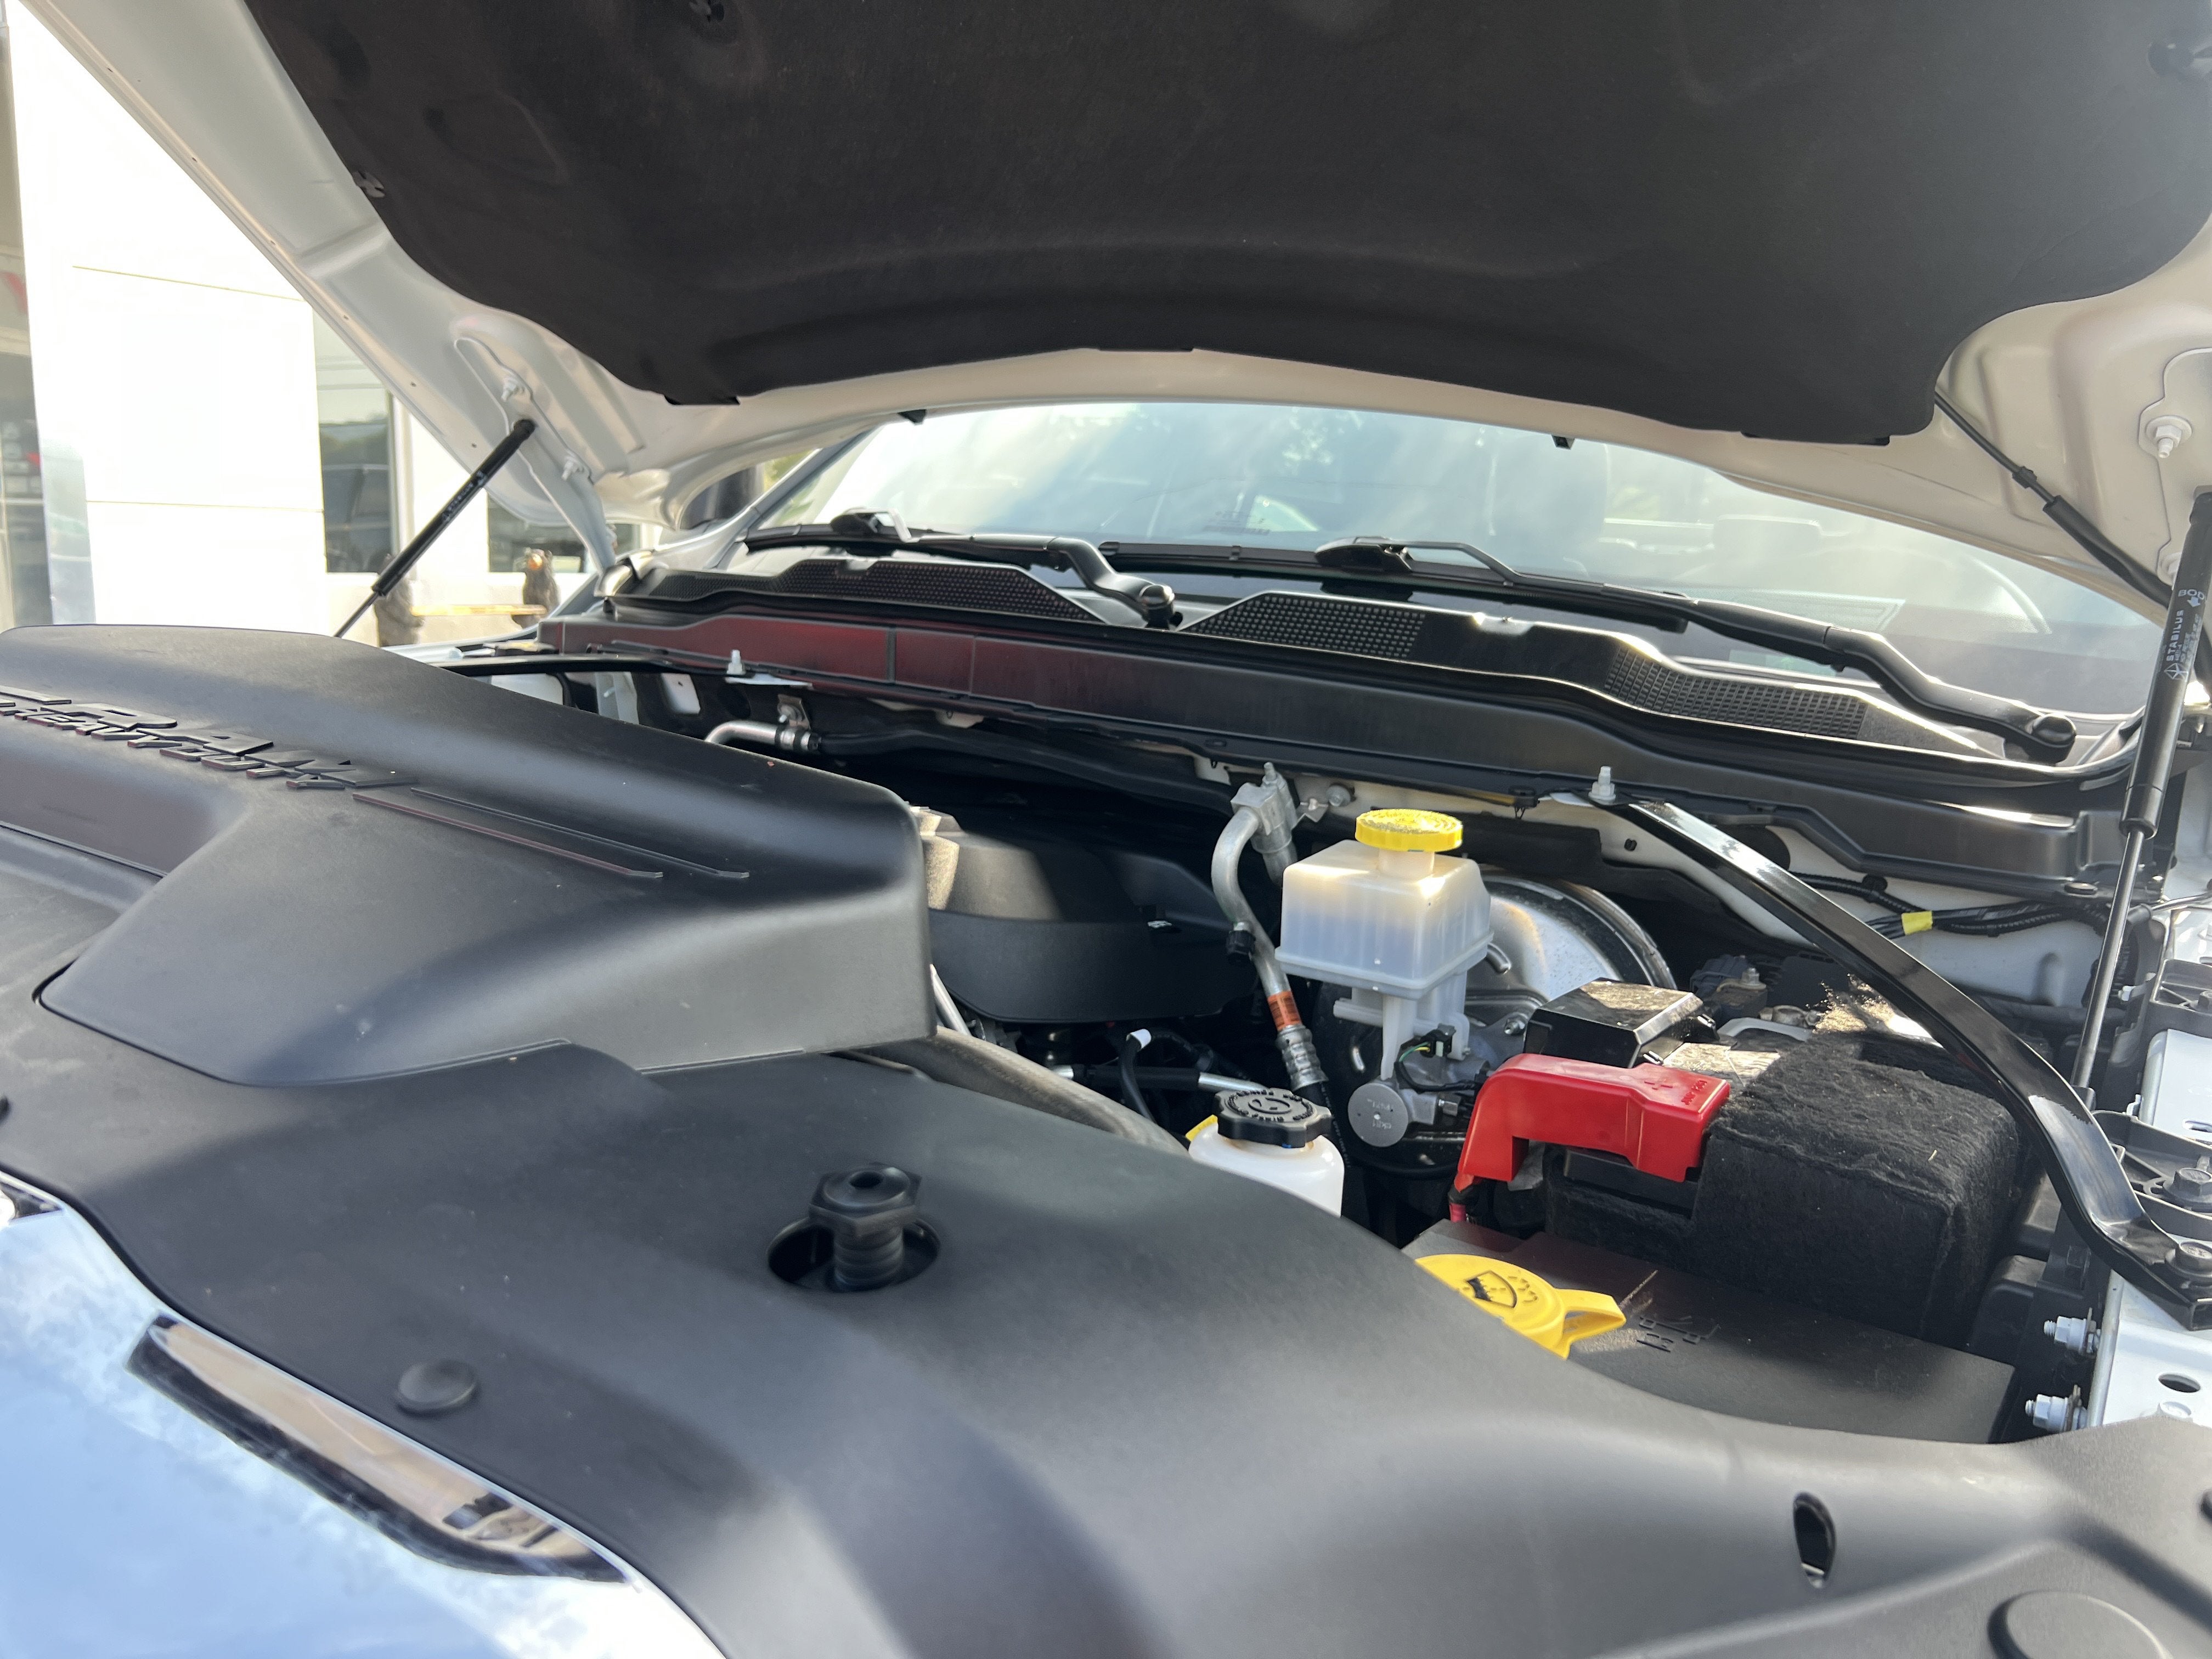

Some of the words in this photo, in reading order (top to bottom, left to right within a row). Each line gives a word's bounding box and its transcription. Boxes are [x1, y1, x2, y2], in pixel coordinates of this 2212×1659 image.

[2166, 610, 2184, 661] STABILUS
[0, 707, 183, 748] HEAVY
[159, 746, 346, 789] DUTY
